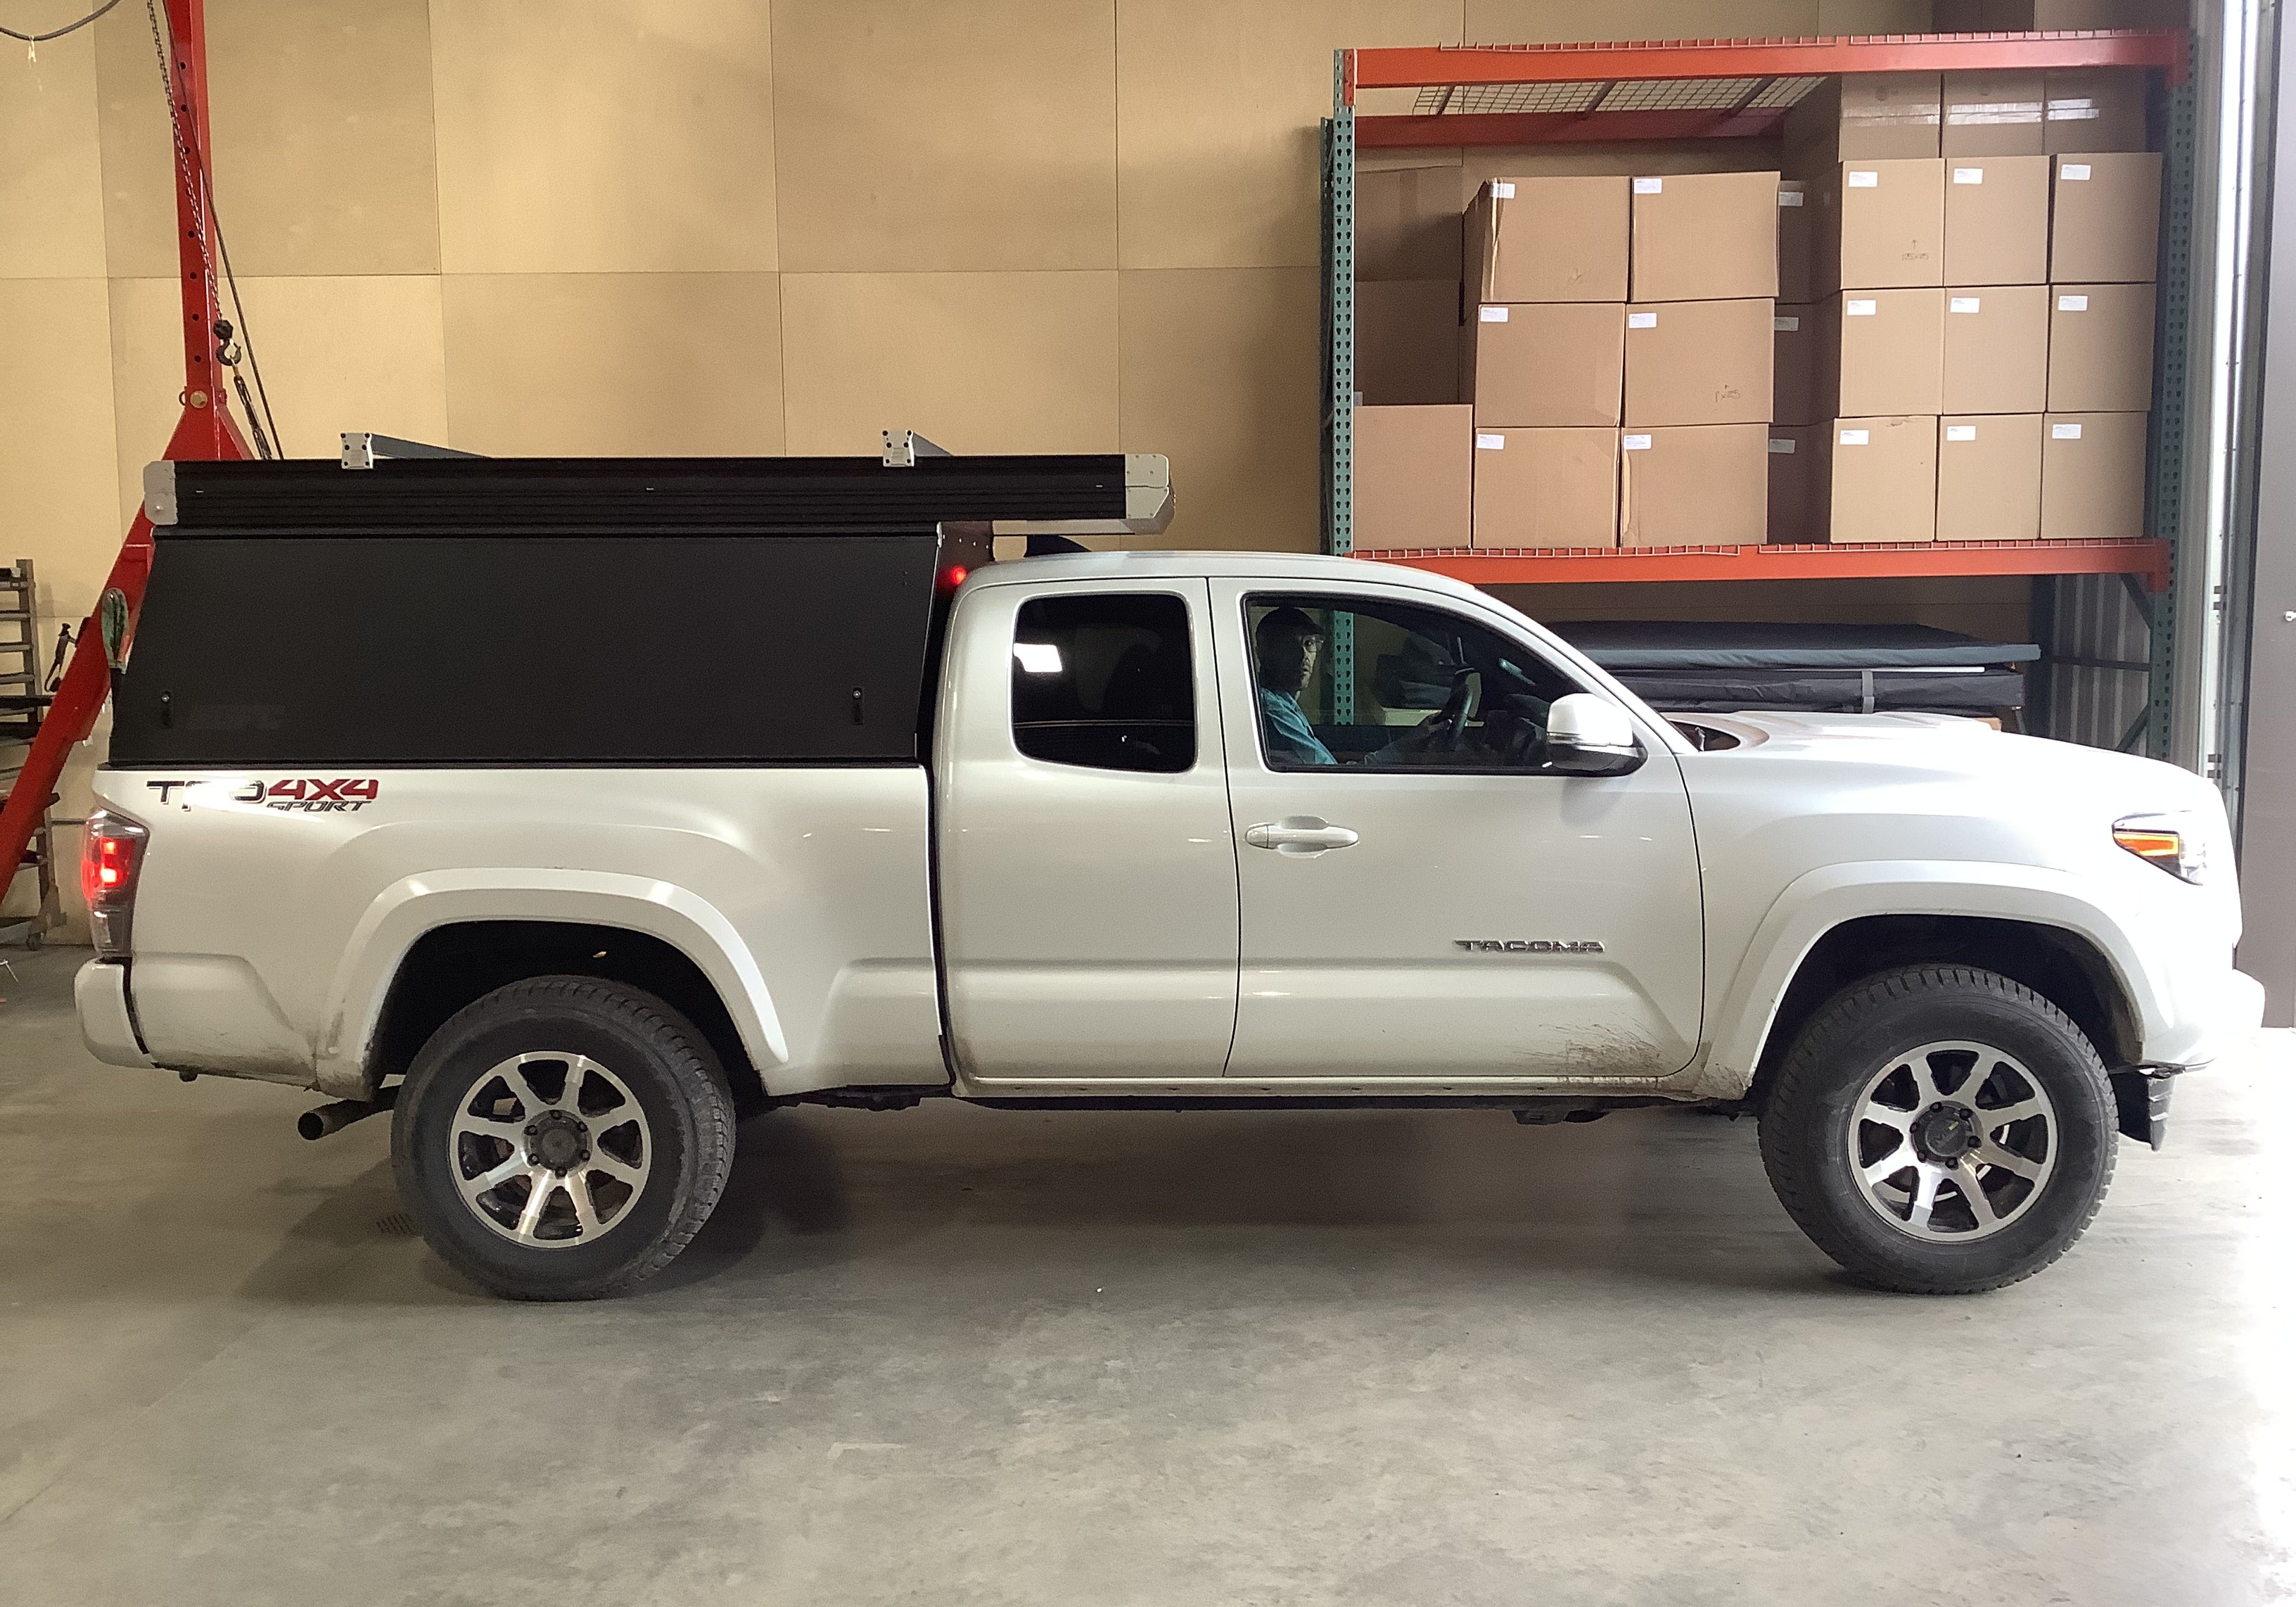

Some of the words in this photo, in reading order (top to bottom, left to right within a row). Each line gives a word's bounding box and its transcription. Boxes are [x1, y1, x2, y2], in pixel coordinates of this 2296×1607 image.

[146, 780, 267, 812] TD
[267, 778, 379, 801] 4X4
[266, 800, 372, 812] SPORT
[1453, 940, 1605, 953] TACOMA
